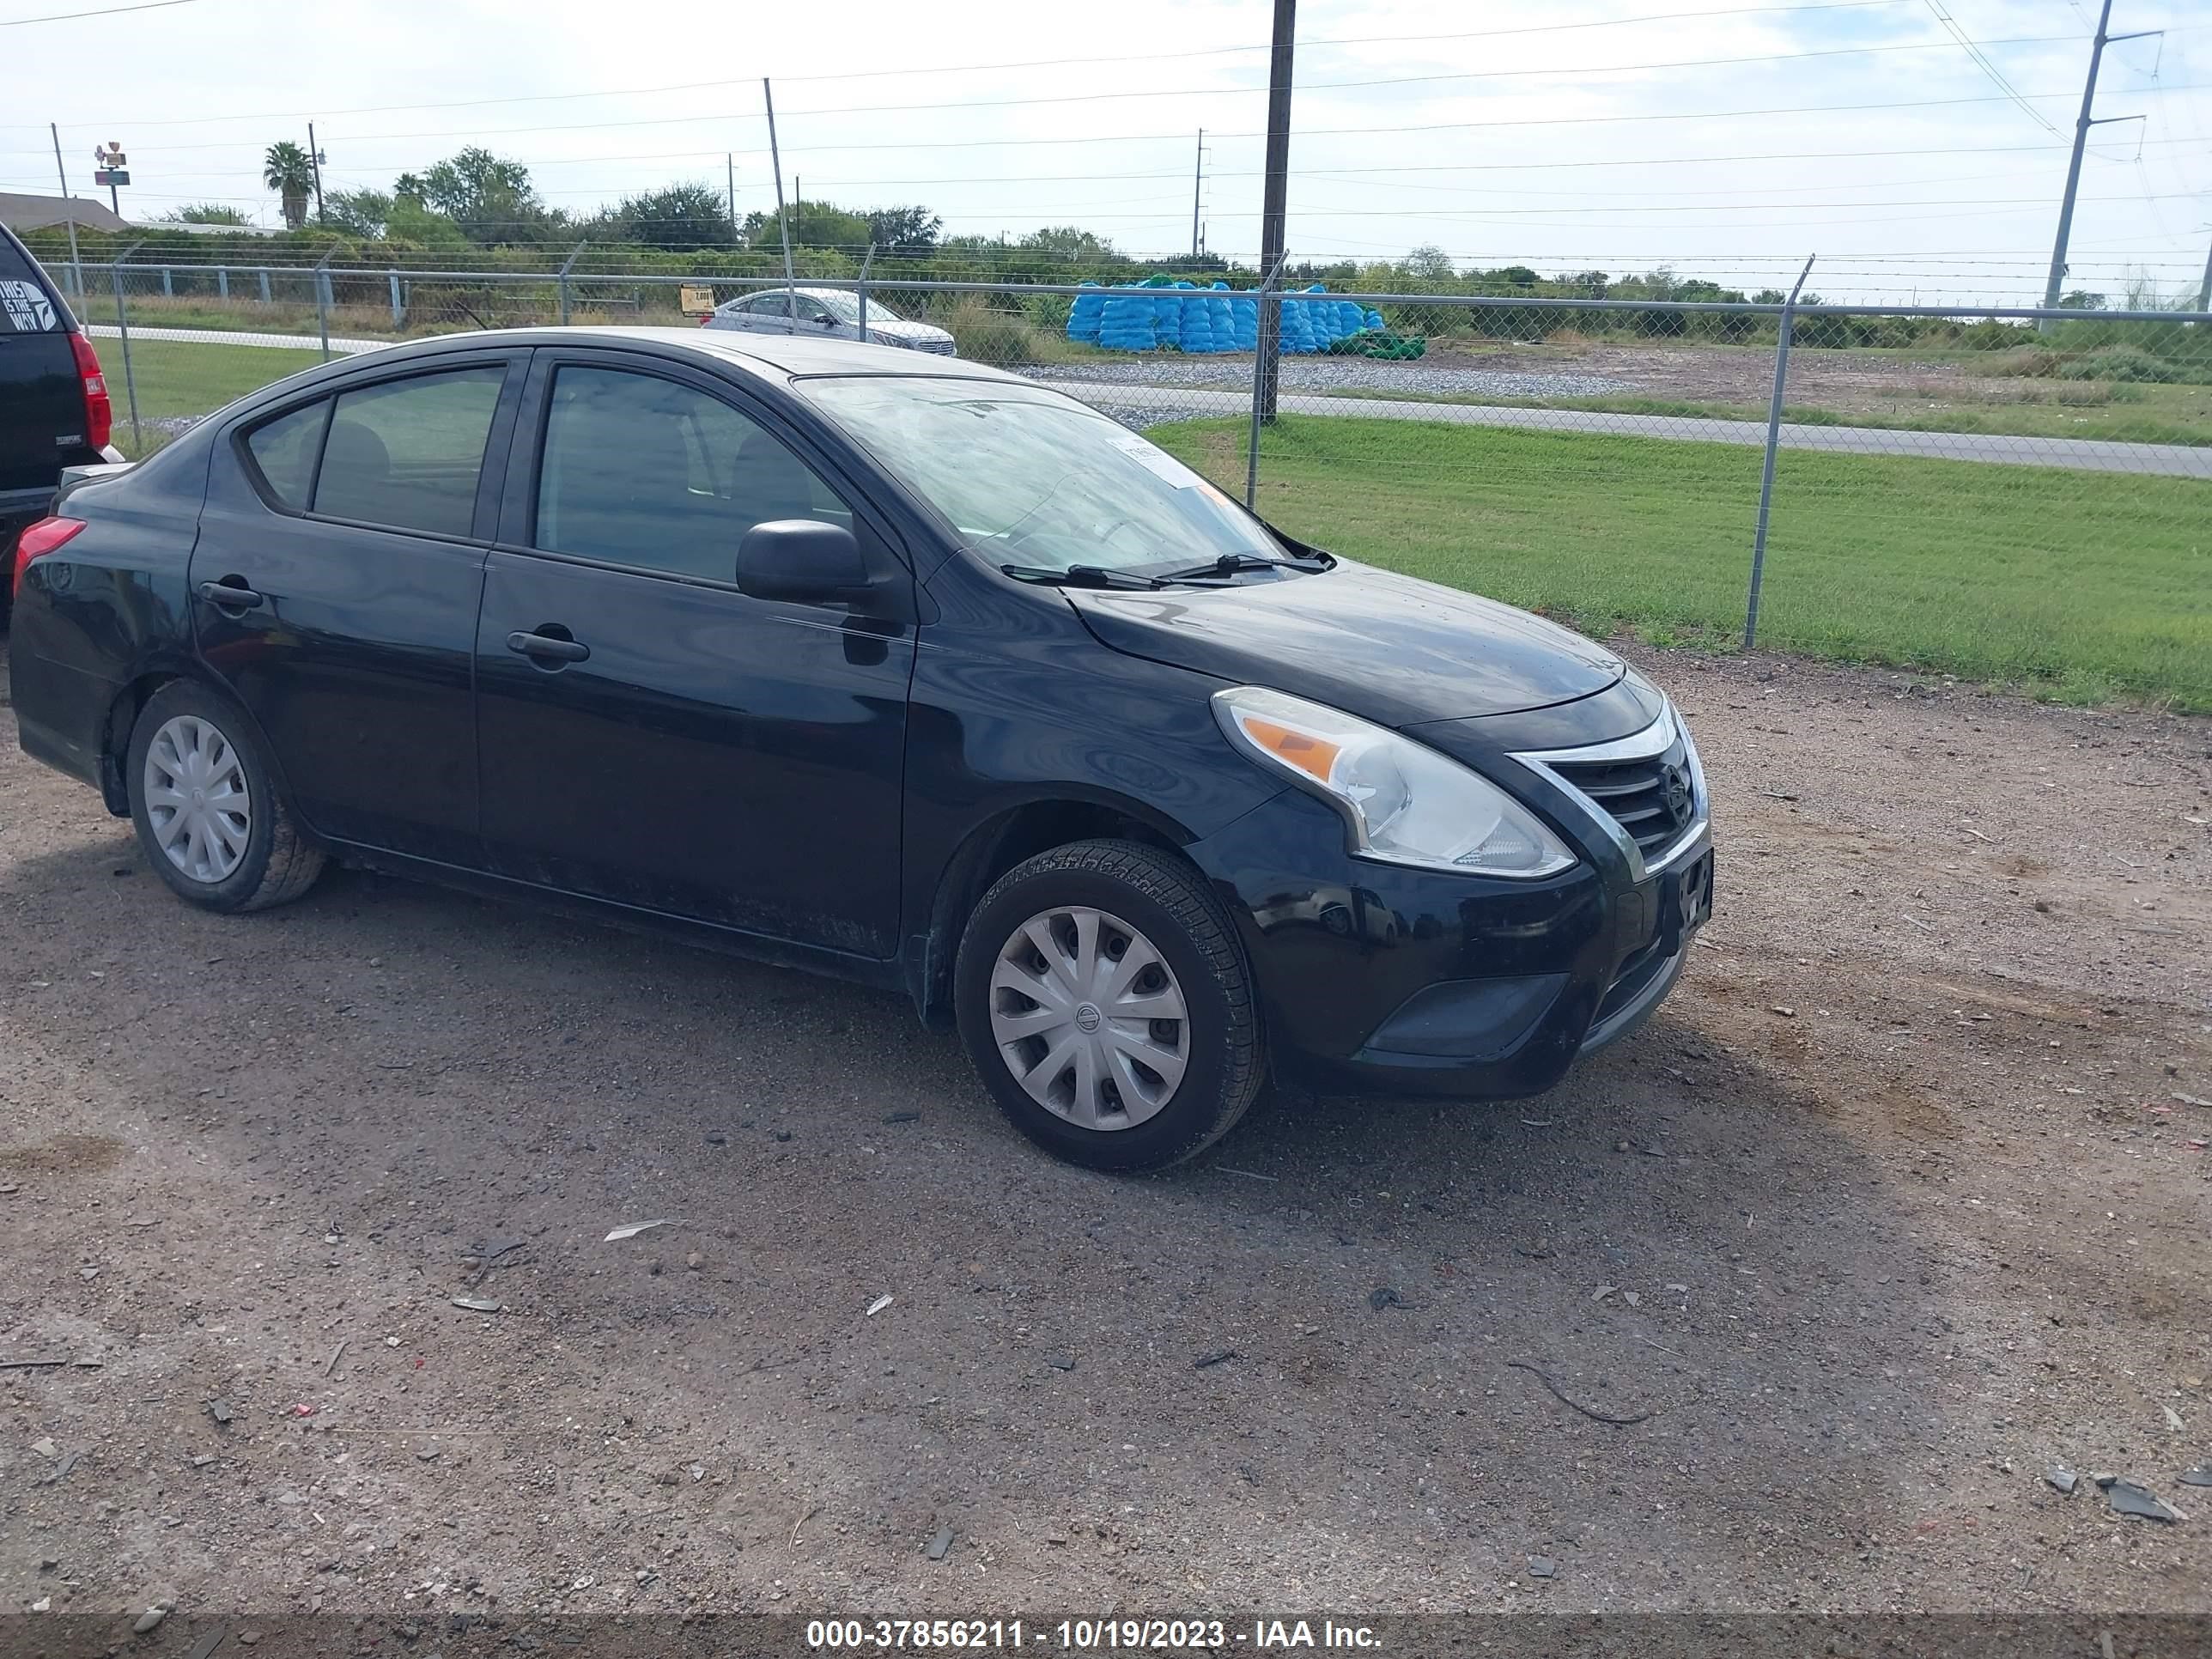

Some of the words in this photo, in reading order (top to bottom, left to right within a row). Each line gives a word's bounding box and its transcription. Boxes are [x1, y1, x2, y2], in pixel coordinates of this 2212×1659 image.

[2, 299, 15, 313] IS
[12, 299, 32, 313] THE
[9, 313, 38, 331] WAY
